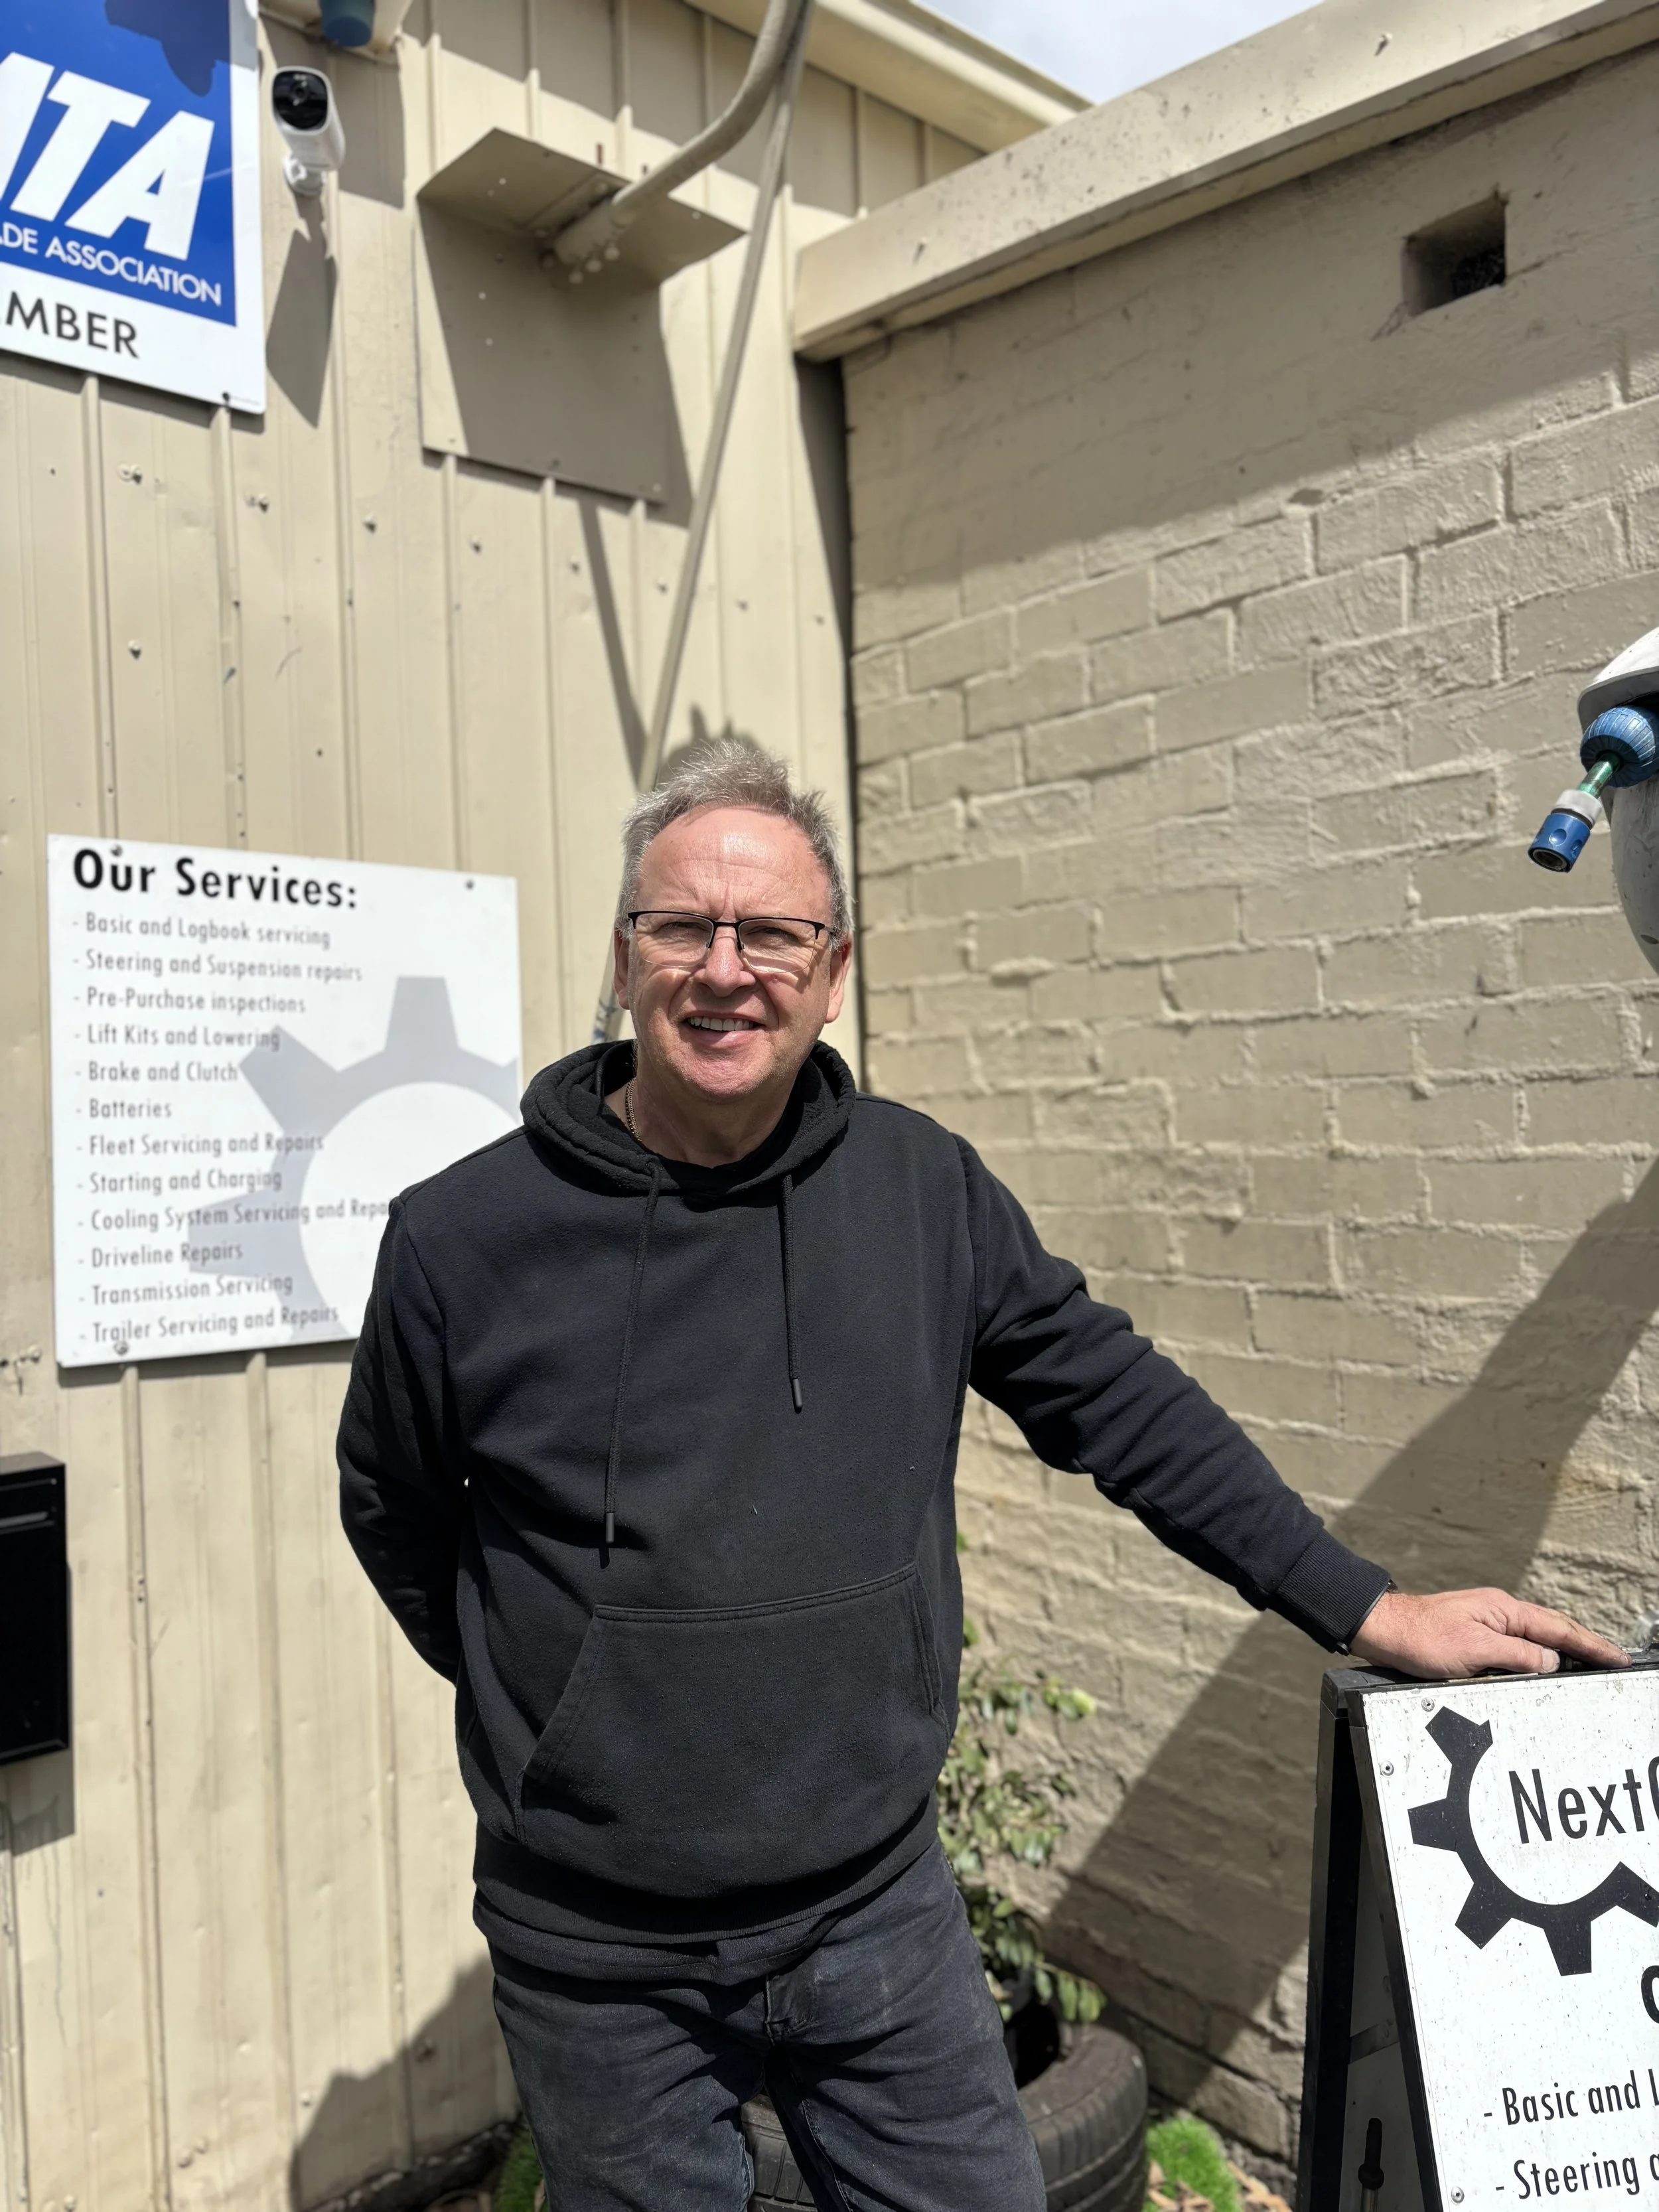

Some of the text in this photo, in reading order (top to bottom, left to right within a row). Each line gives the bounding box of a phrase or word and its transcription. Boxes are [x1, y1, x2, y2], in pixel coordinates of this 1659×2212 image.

[0, 222, 222, 307] DE ASSOCIATION
[74, 849, 356, 909] Our Services:
[87, 912, 132, 934] Basic
[139, 917, 173, 937] and
[179, 919, 251, 944] Logbook
[257, 928, 330, 951] servicing
[87, 949, 163, 978] Steering
[171, 954, 202, 975] and
[208, 954, 302, 982] Suspension
[308, 966, 362, 985] repairs
[88, 986, 205, 1010] Pre-Purchase
[212, 994, 307, 1017] inspections
[88, 1024, 117, 1045] Lift
[125, 1026, 159, 1045] Kits
[166, 1026, 198, 1046] and
[204, 1025, 283, 1053] Lowering
[90, 1061, 141, 1082] Brake
[148, 1062, 180, 1082] and
[186, 1062, 240, 1082] Clutch
[90, 1098, 172, 1119] Batteries
[90, 1136, 135, 1155] Fleet
[141, 1134, 222, 1159] Servicing
[228, 1133, 259, 1153] and
[265, 1132, 324, 1156] Repairs
[90, 1173, 163, 1197] Starting
[169, 1170, 201, 1191] and
[208, 1169, 283, 1193] Charging
[92, 1209, 159, 1234] Cooling
[165, 1207, 228, 1232] System
[232, 1199, 310, 1224] Servicing
[317, 1200, 346, 1220] and
[351, 1199, 389, 1221] Repa
[92, 1245, 174, 1269] Driveline
[182, 1244, 244, 1268] Repairs
[93, 1283, 210, 1306] Transmission
[216, 1276, 293, 1297] Servicing
[94, 1320, 151, 1341] Trailer
[159, 1317, 238, 1338] Servicing
[245, 1309, 275, 1330] and
[282, 1305, 338, 1331] Repairs
[1502, 2082, 1579, 2125] Basic
[1588, 2069, 1640, 2115] and
[1514, 2151, 1640, 2199] Steering
